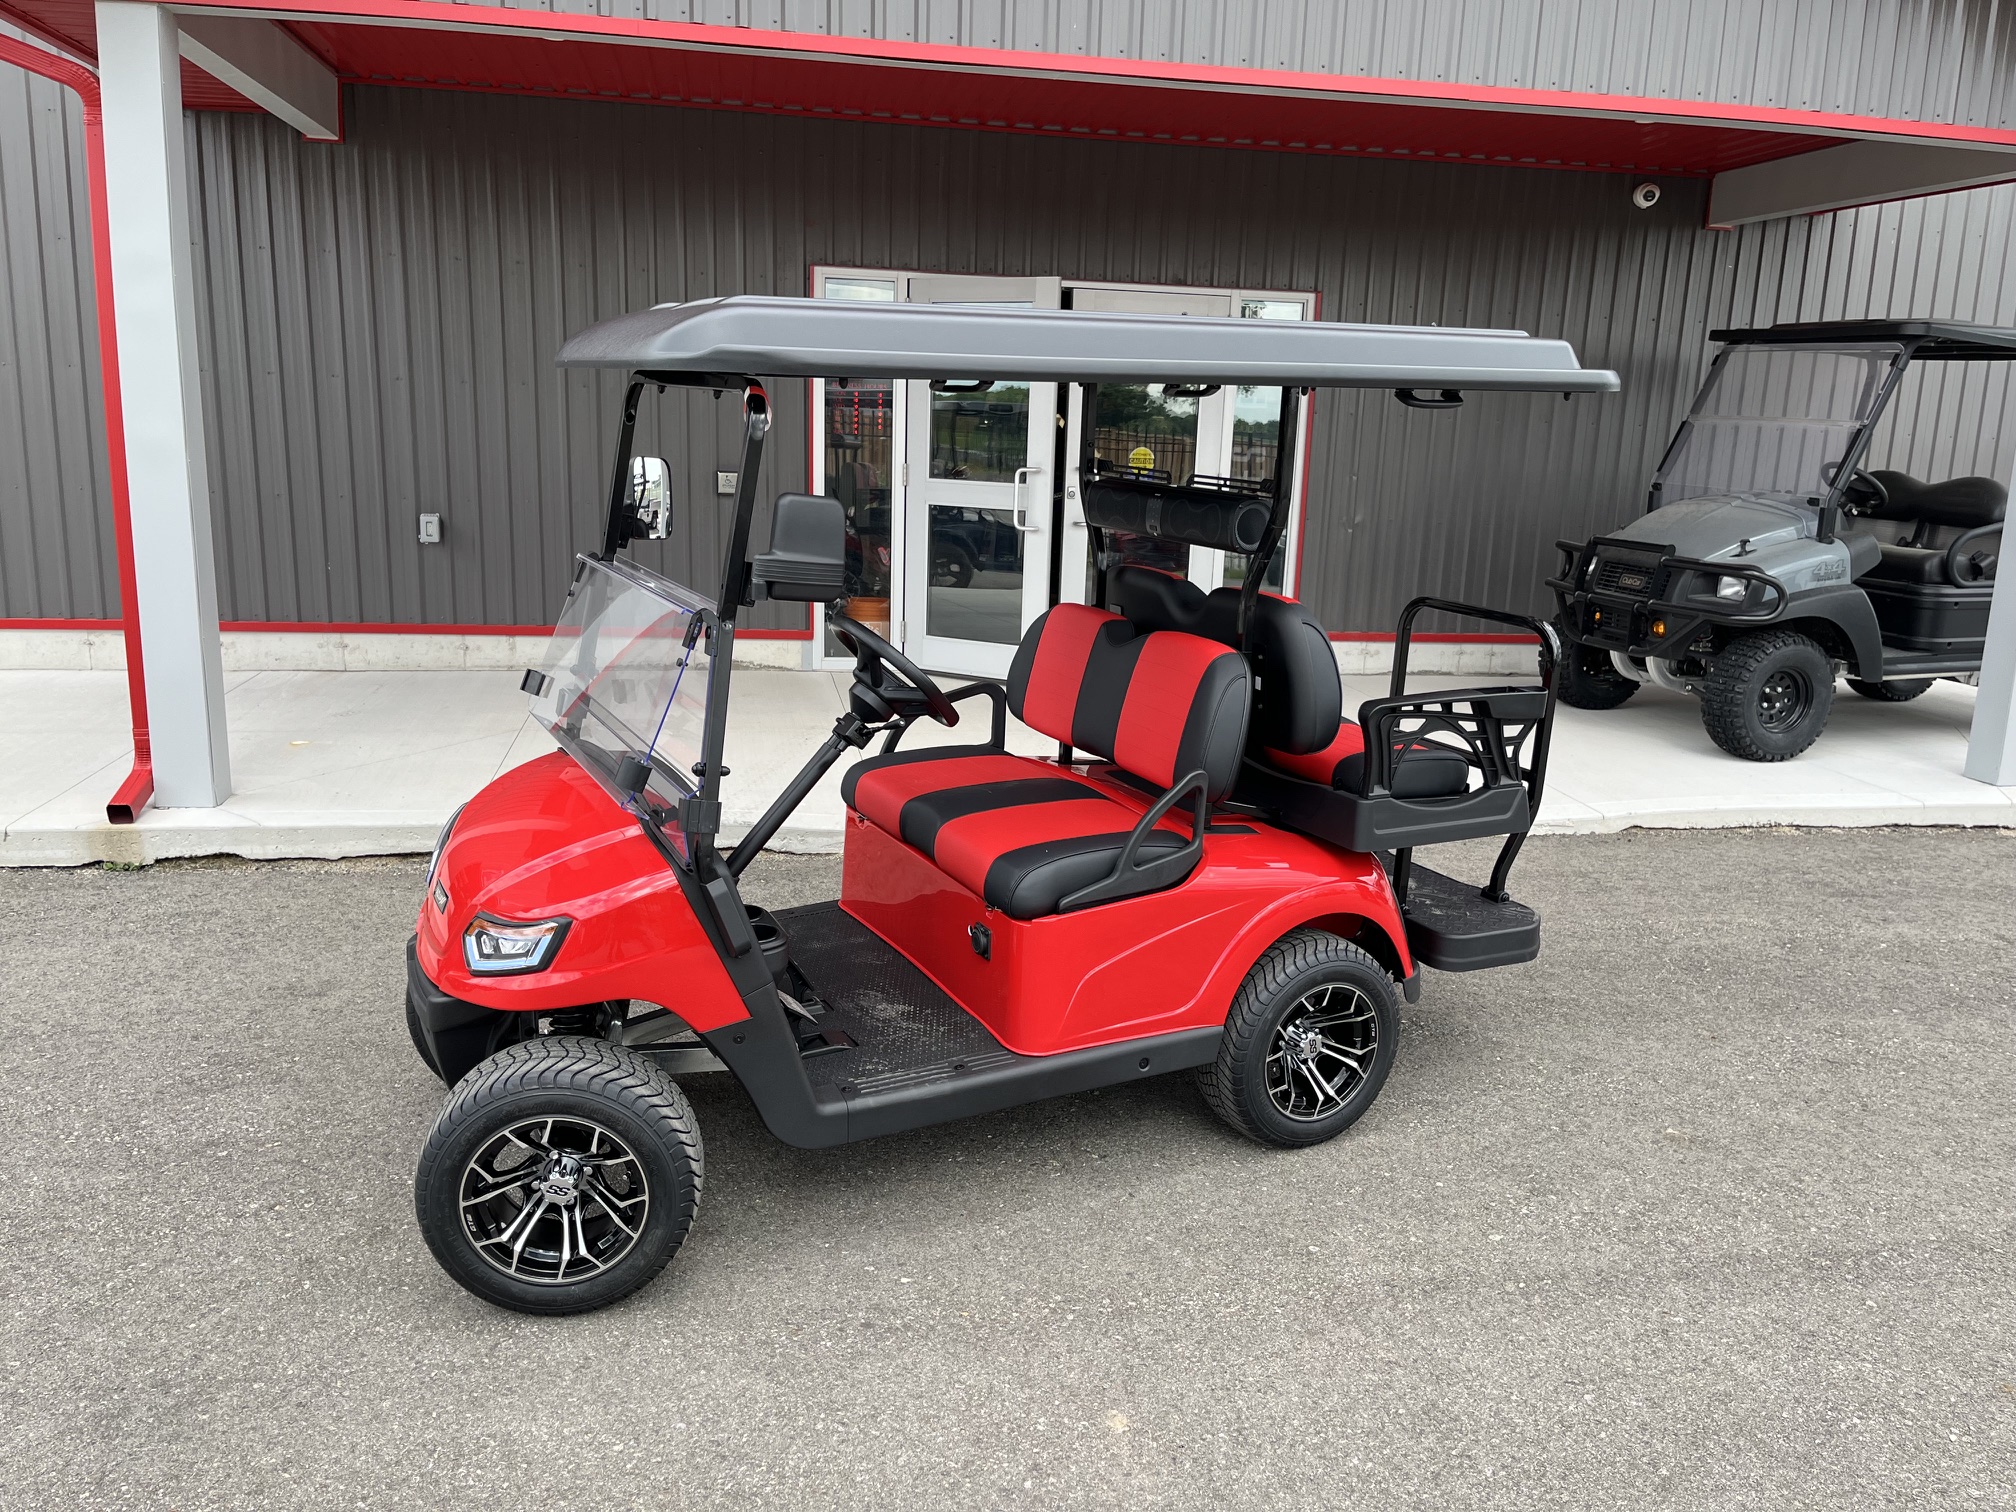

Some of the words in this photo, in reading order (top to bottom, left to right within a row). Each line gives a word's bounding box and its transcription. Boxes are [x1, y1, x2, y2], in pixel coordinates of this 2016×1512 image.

[1812, 559, 1846, 577] 4x4
[1309, 1039, 1317, 1054] SS
[546, 1184, 571, 1197] SS
